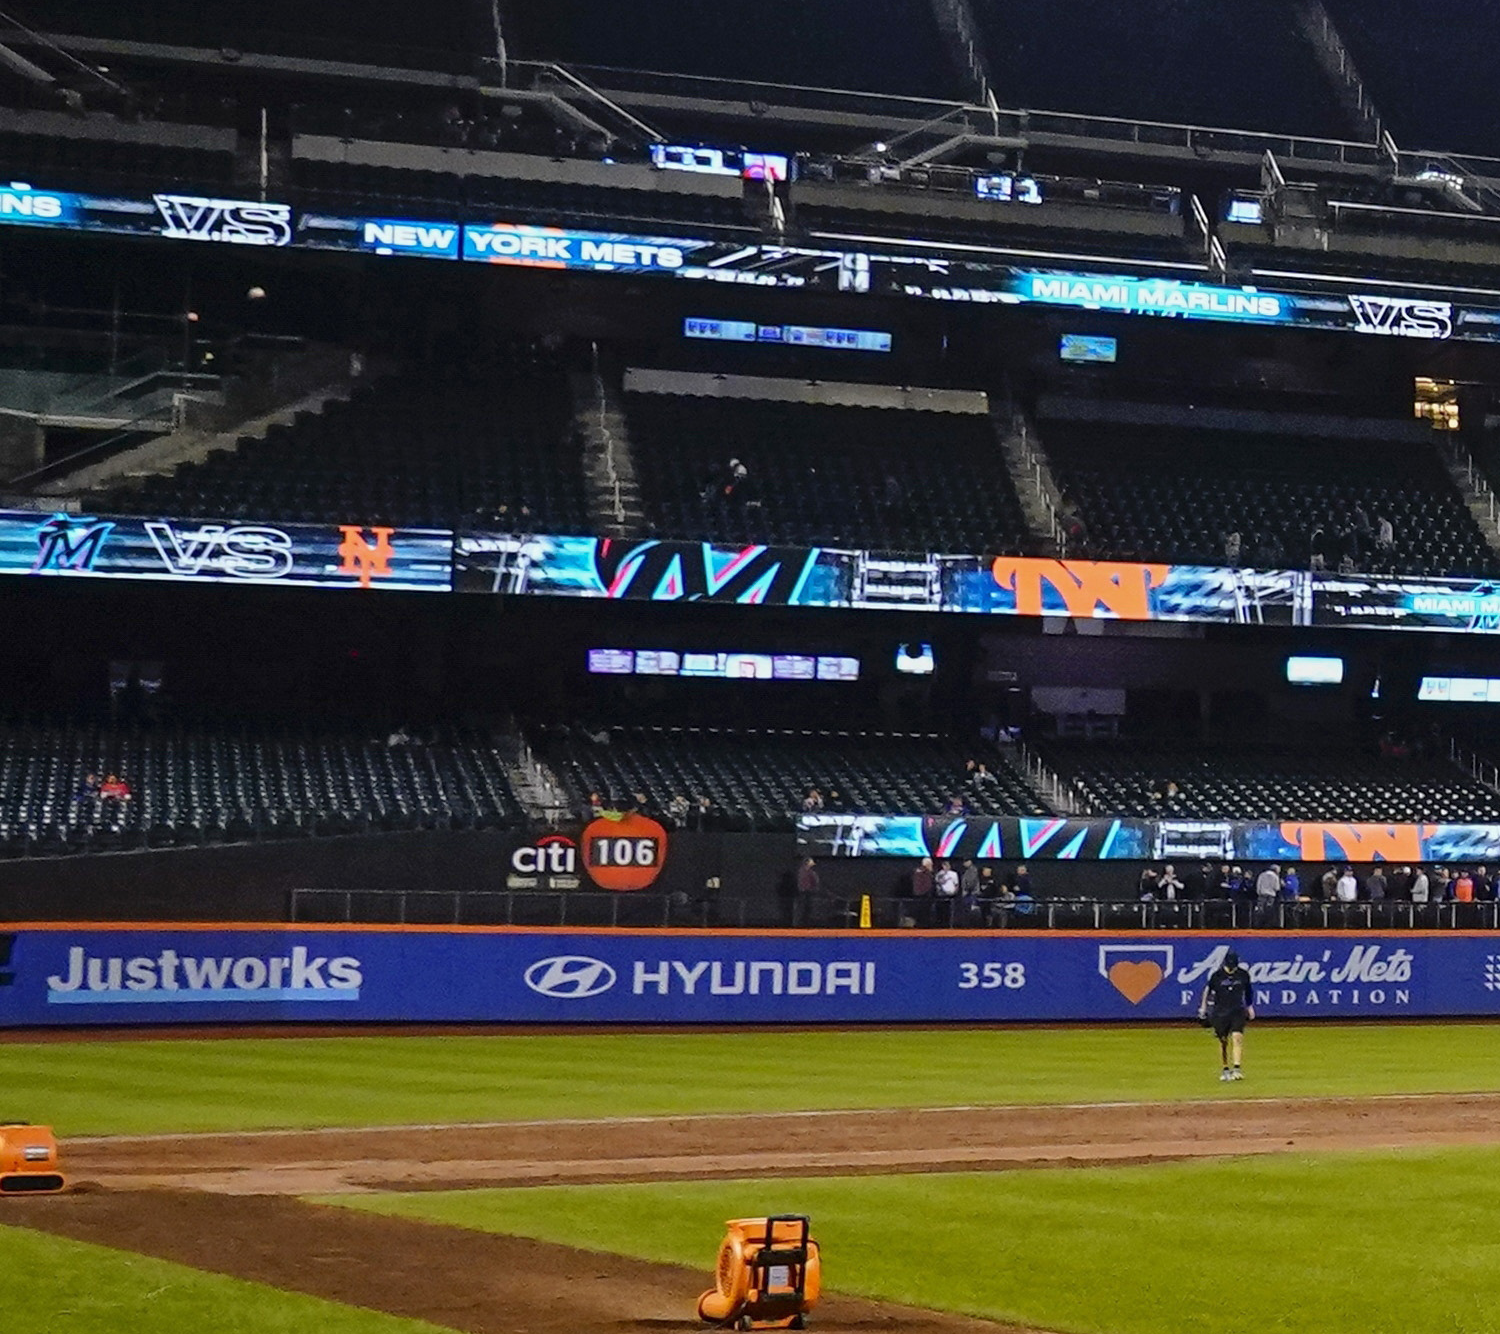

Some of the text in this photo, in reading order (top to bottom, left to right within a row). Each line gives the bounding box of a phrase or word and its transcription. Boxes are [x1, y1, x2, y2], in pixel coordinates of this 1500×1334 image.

[153, 194, 684, 268] VS NEW YORK METS
[1032, 278, 1129, 305] MIAMI
[1138, 285, 1281, 316] MARLINS
[1348, 294, 1454, 340] VS
[1413, 597, 1475, 613] MIAMI
[512, 841, 576, 873] citi
[597, 839, 655, 866] 106
[47, 946, 364, 992] Justworks
[632, 961, 876, 995] HYUNDAI
[958, 962, 1026, 989] 358
[1177, 944, 1415, 984] Aazin' Mets
[1181, 989, 1410, 1006] FNDATION
